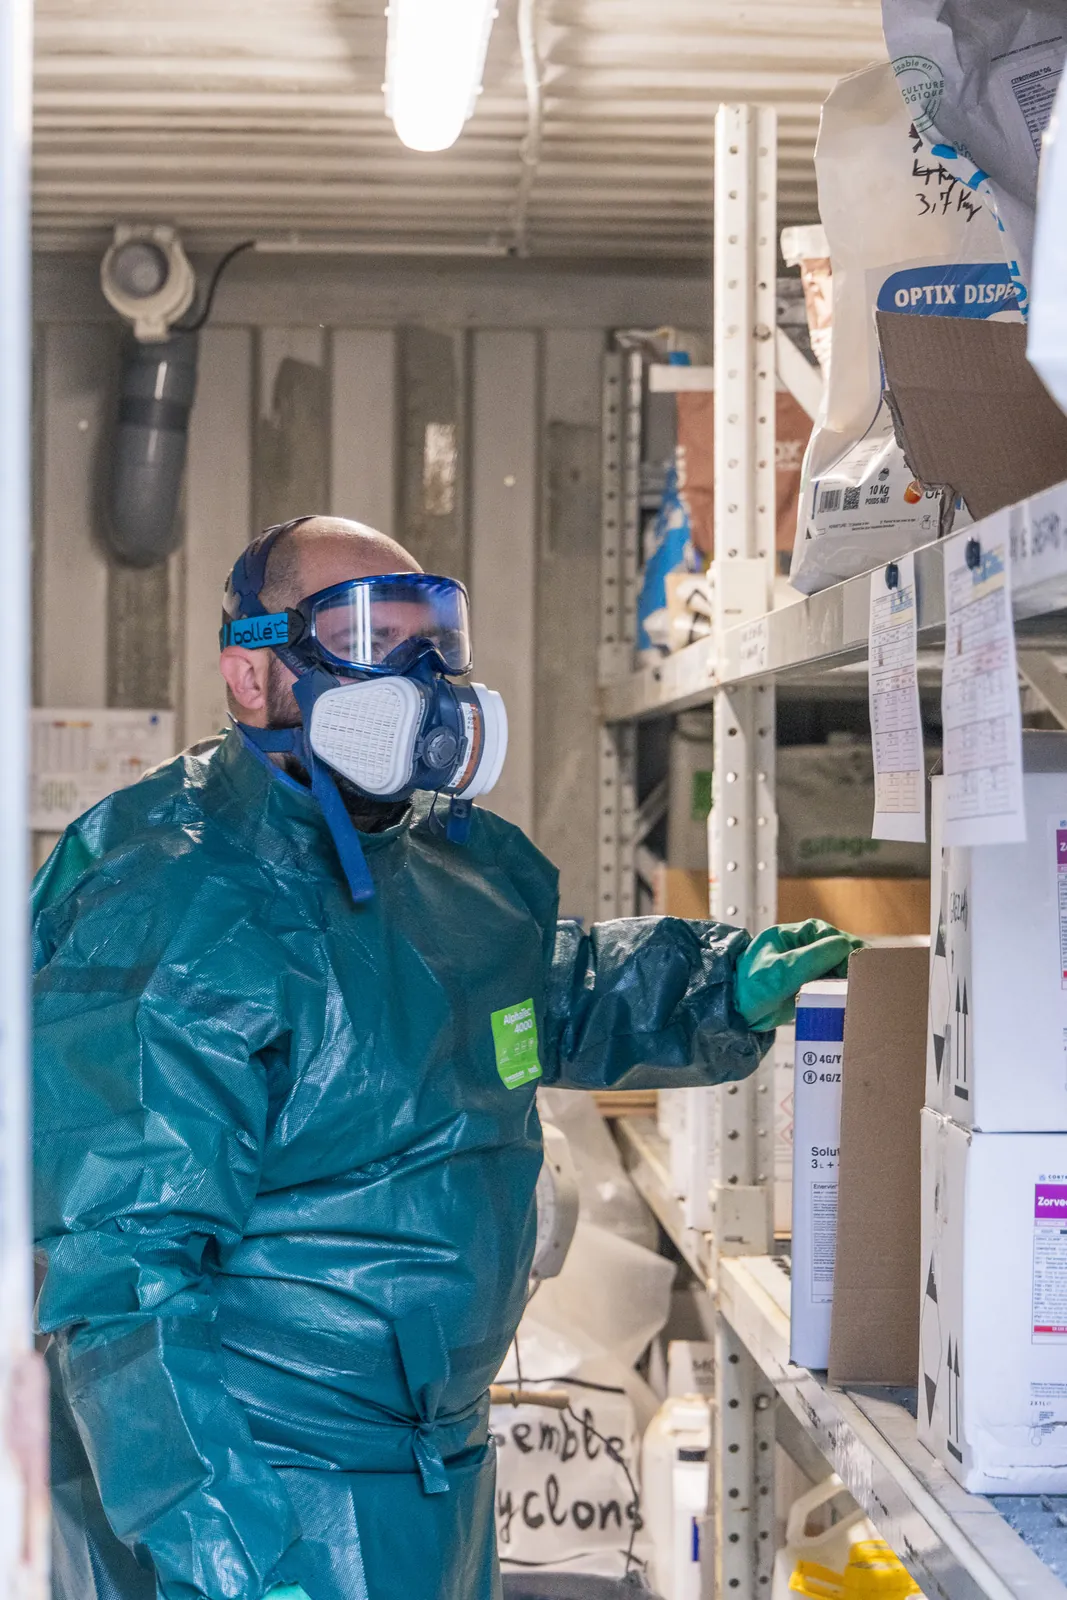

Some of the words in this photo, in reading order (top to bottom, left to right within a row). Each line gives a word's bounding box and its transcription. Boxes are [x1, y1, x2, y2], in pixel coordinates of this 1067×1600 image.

[901, 80, 945, 97] CULTURE
[904, 88, 944, 105] OGIQUE
[870, 484, 879, 496] 10
[879, 484, 890, 497] Kg
[233, 621, 273, 645] bollé
[819, 1054, 842, 1064] 4G/Y
[819, 1073, 842, 1083] 4G/Z
